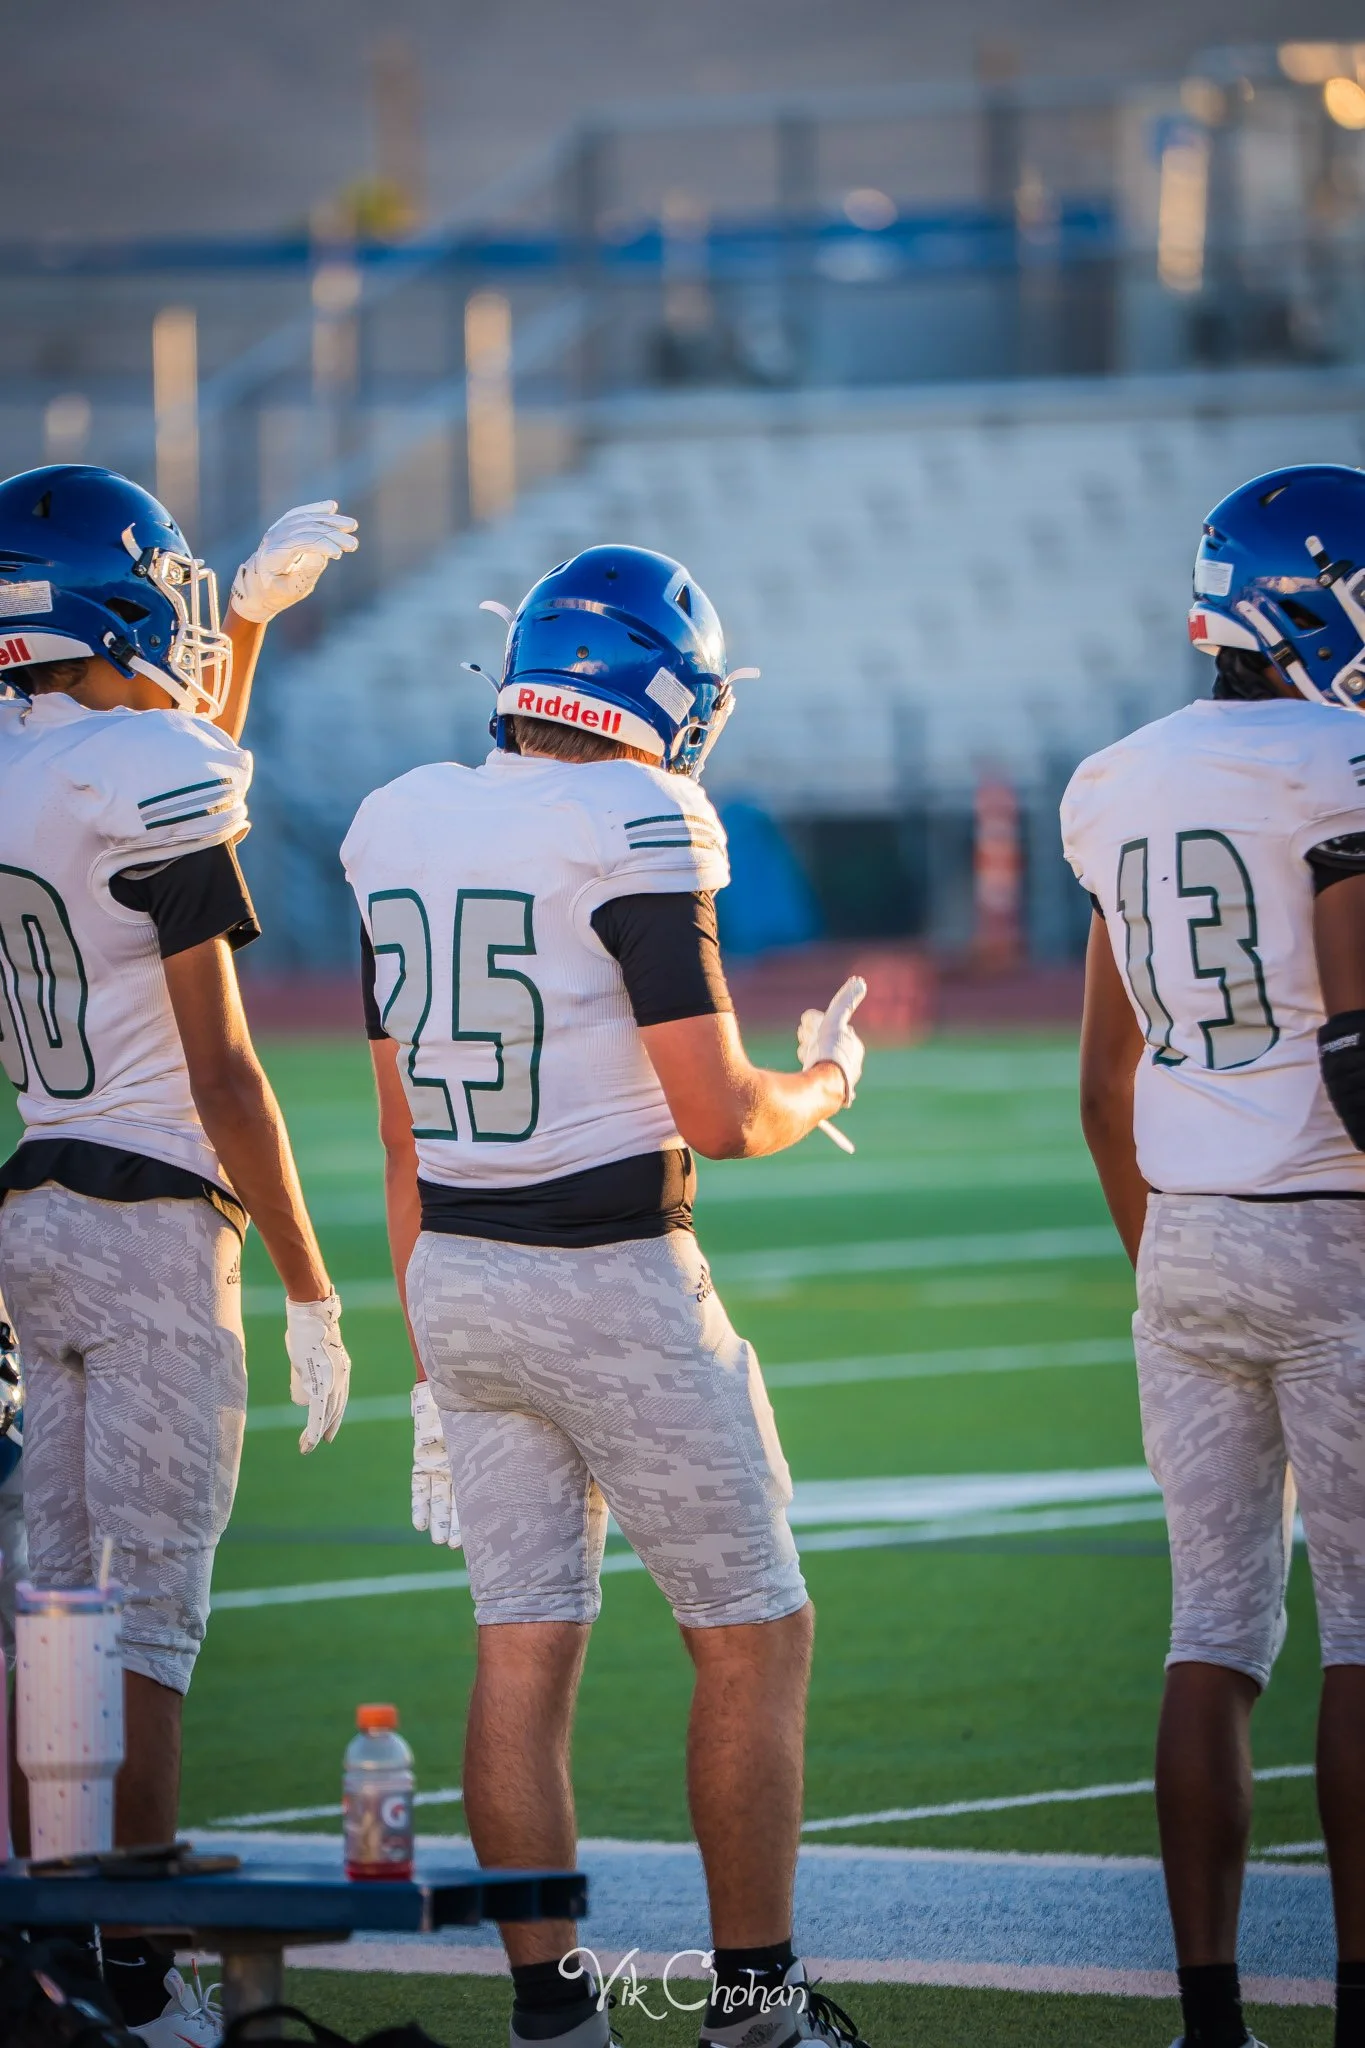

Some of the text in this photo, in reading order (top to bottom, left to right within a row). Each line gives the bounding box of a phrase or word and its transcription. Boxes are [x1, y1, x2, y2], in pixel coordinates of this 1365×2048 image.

[517, 688, 622, 734] Riddell
[0, 863, 96, 1100] 0
[368, 888, 544, 1143] 25
[1116, 829, 1280, 1071] 13
